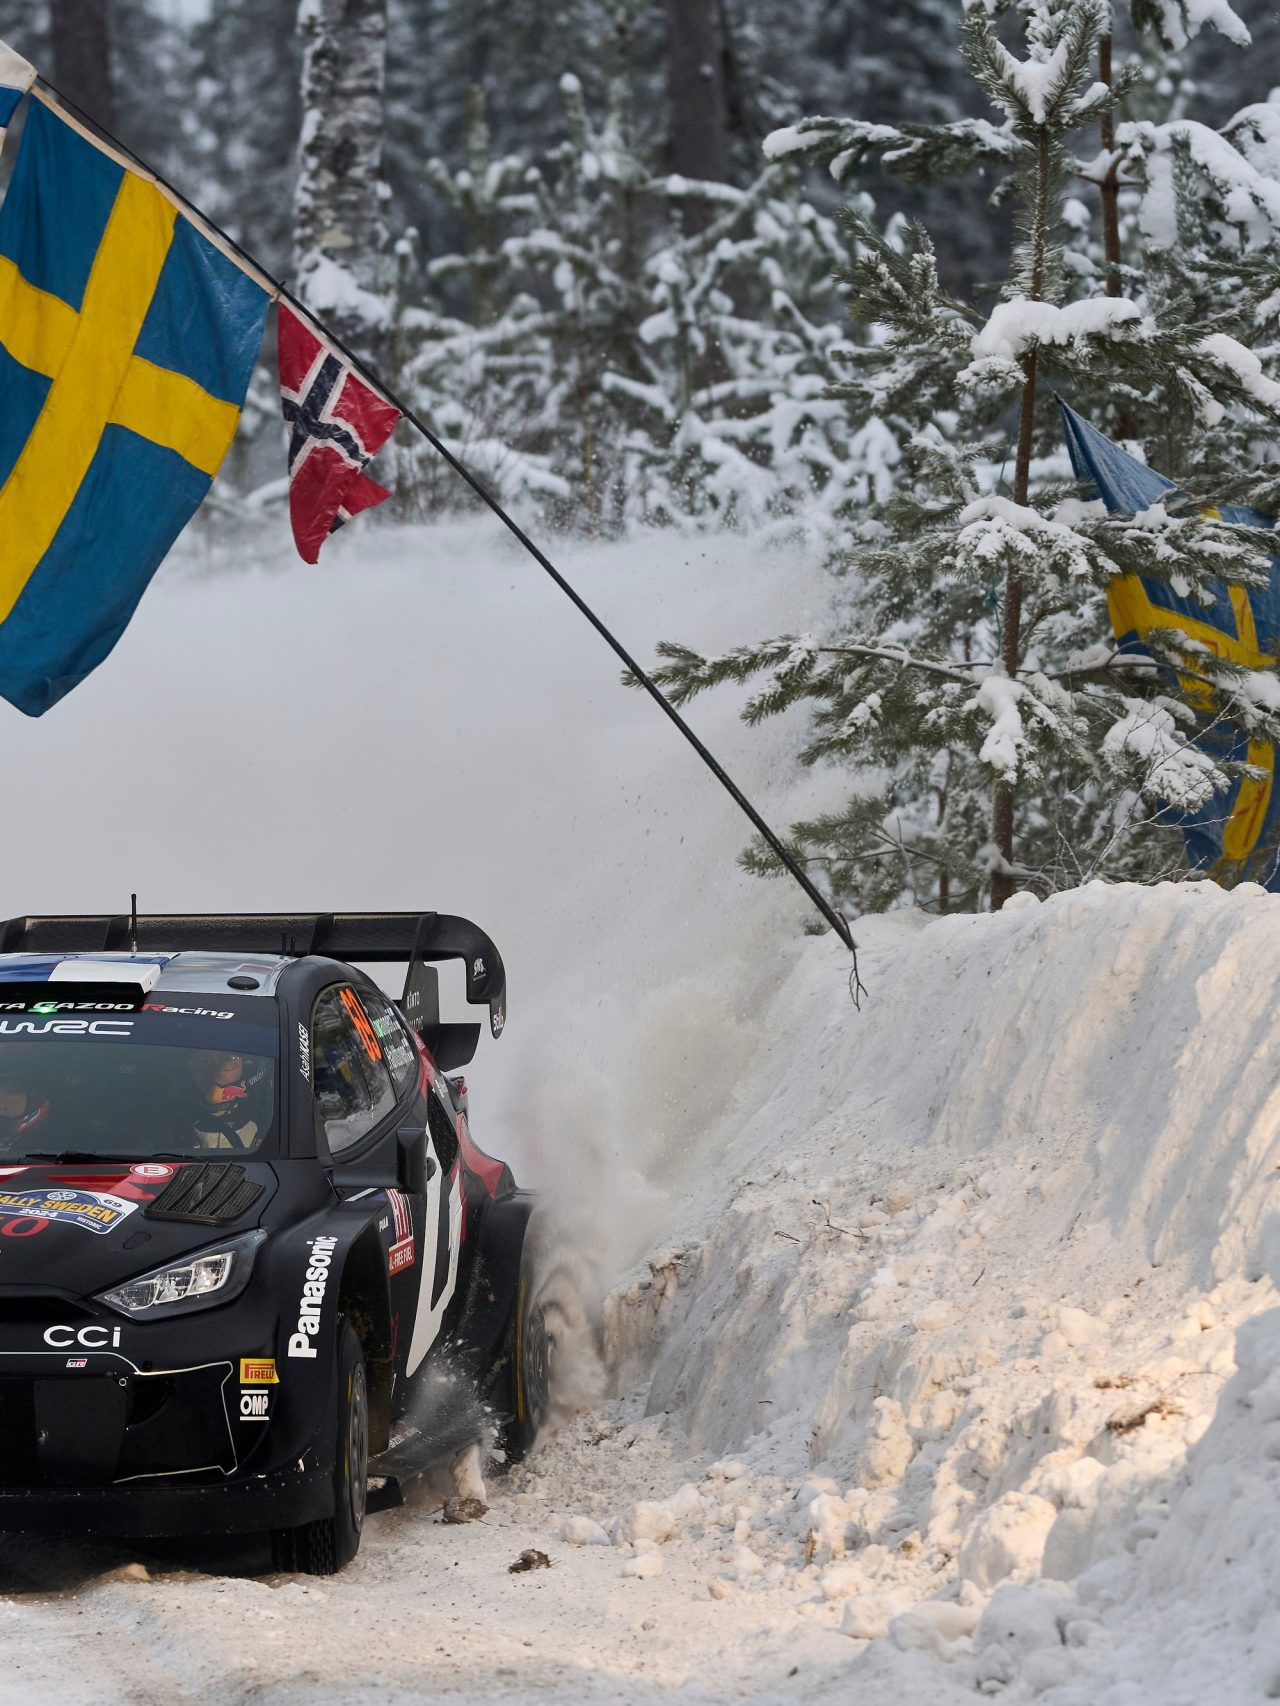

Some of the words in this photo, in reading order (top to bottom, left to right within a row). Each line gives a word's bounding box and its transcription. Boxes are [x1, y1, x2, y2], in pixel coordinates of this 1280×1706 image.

[29, 1001, 135, 1012] GAZOO
[140, 1003, 235, 1020] Racing
[143, 1166, 160, 1175] E
[19, 1208, 60, 1219] 2024
[40, 1200, 119, 1224] SWEDEN
[76, 1216, 103, 1230] HISTORIC
[287, 1236, 339, 1359] Panasonic
[240, 1395, 269, 1415] OMP
